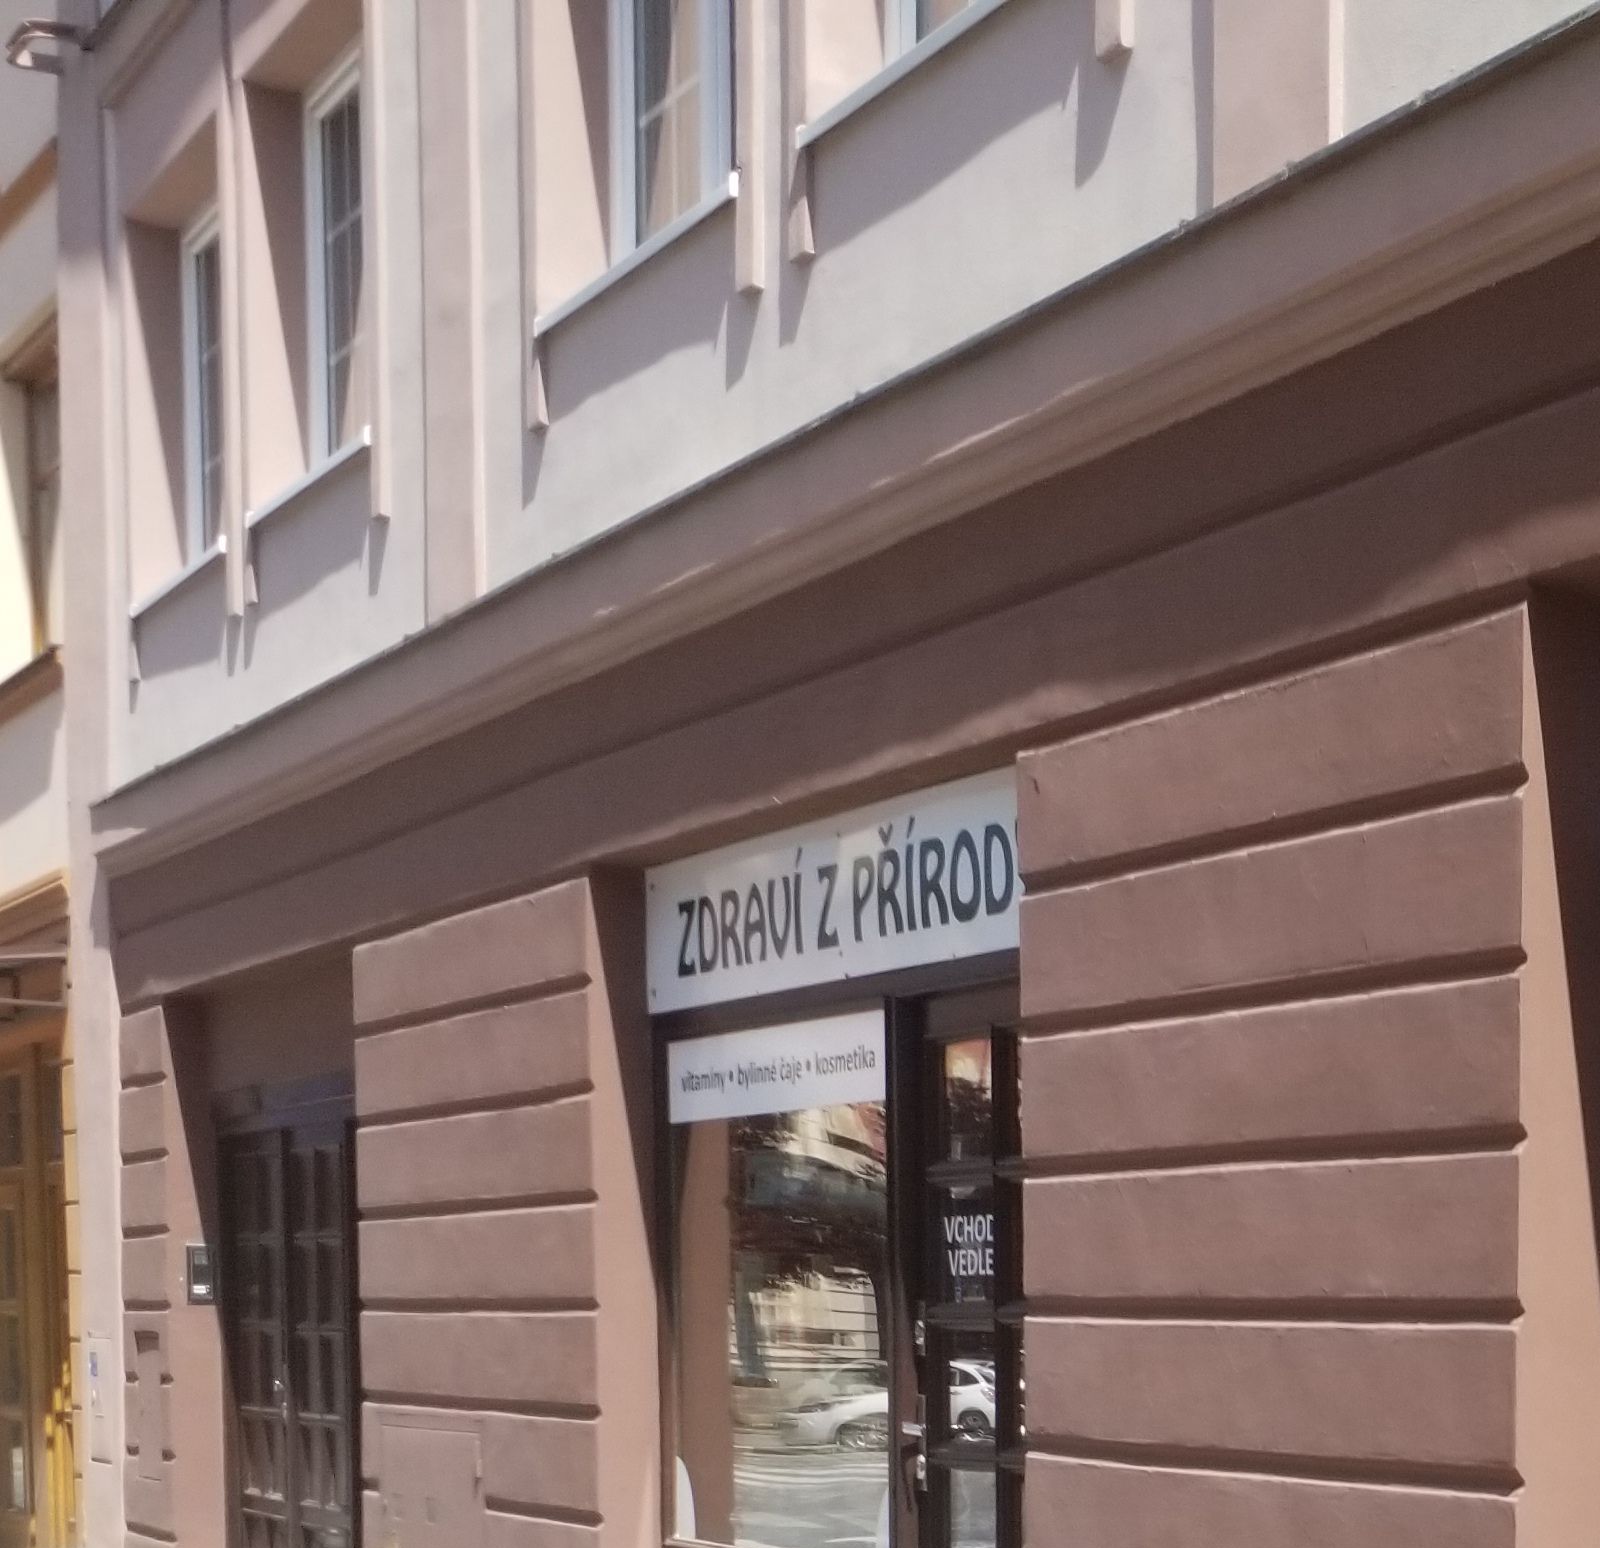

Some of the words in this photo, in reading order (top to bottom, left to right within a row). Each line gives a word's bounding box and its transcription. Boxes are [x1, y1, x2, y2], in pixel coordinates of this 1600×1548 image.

[677, 846, 805, 978] ZDRAVÍ
[817, 864, 841, 951] Z
[853, 815, 1018, 943] PŘÍROD
[737, 1058, 777, 1089] bylinné
[780, 1056, 803, 1084] čaje
[814, 1044, 876, 1077] kosmetika
[947, 1248, 995, 1277] VEDLE
